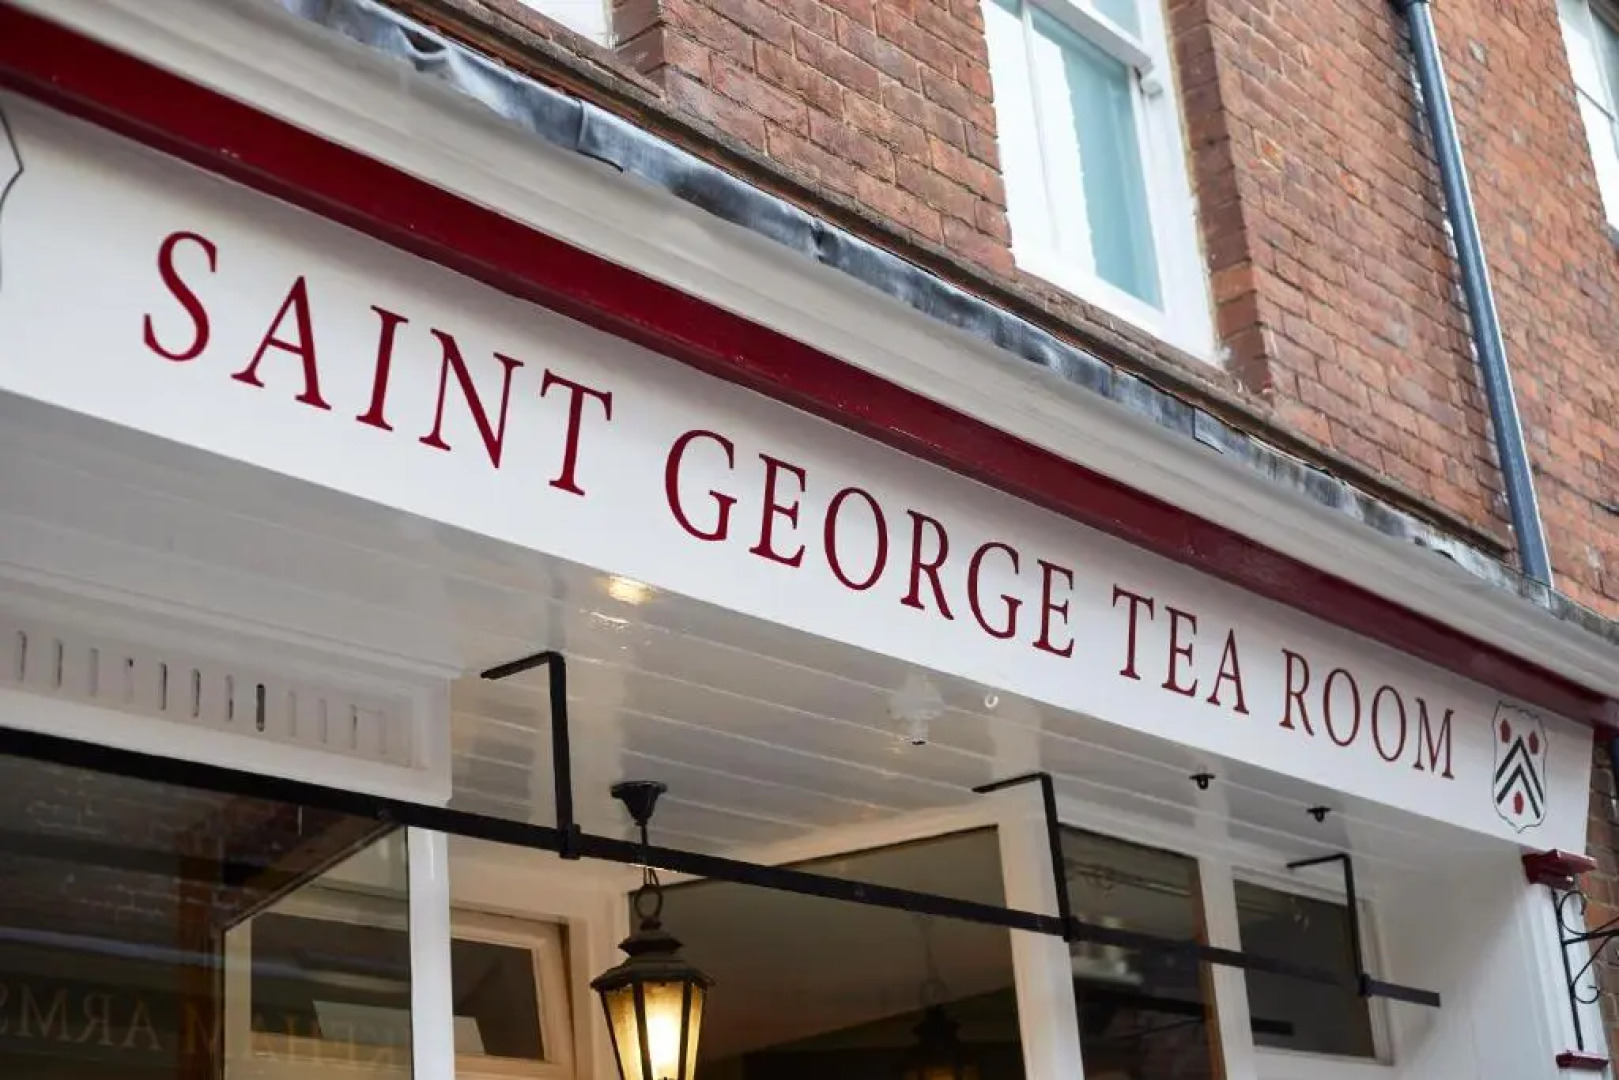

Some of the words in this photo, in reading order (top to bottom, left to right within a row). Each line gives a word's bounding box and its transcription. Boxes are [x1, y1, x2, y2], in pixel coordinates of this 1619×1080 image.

[143, 231, 612, 496] SAINT
[664, 429, 1074, 658] GEORGE
[1113, 584, 1249, 715] TEA
[1279, 648, 1455, 779] ROOM
